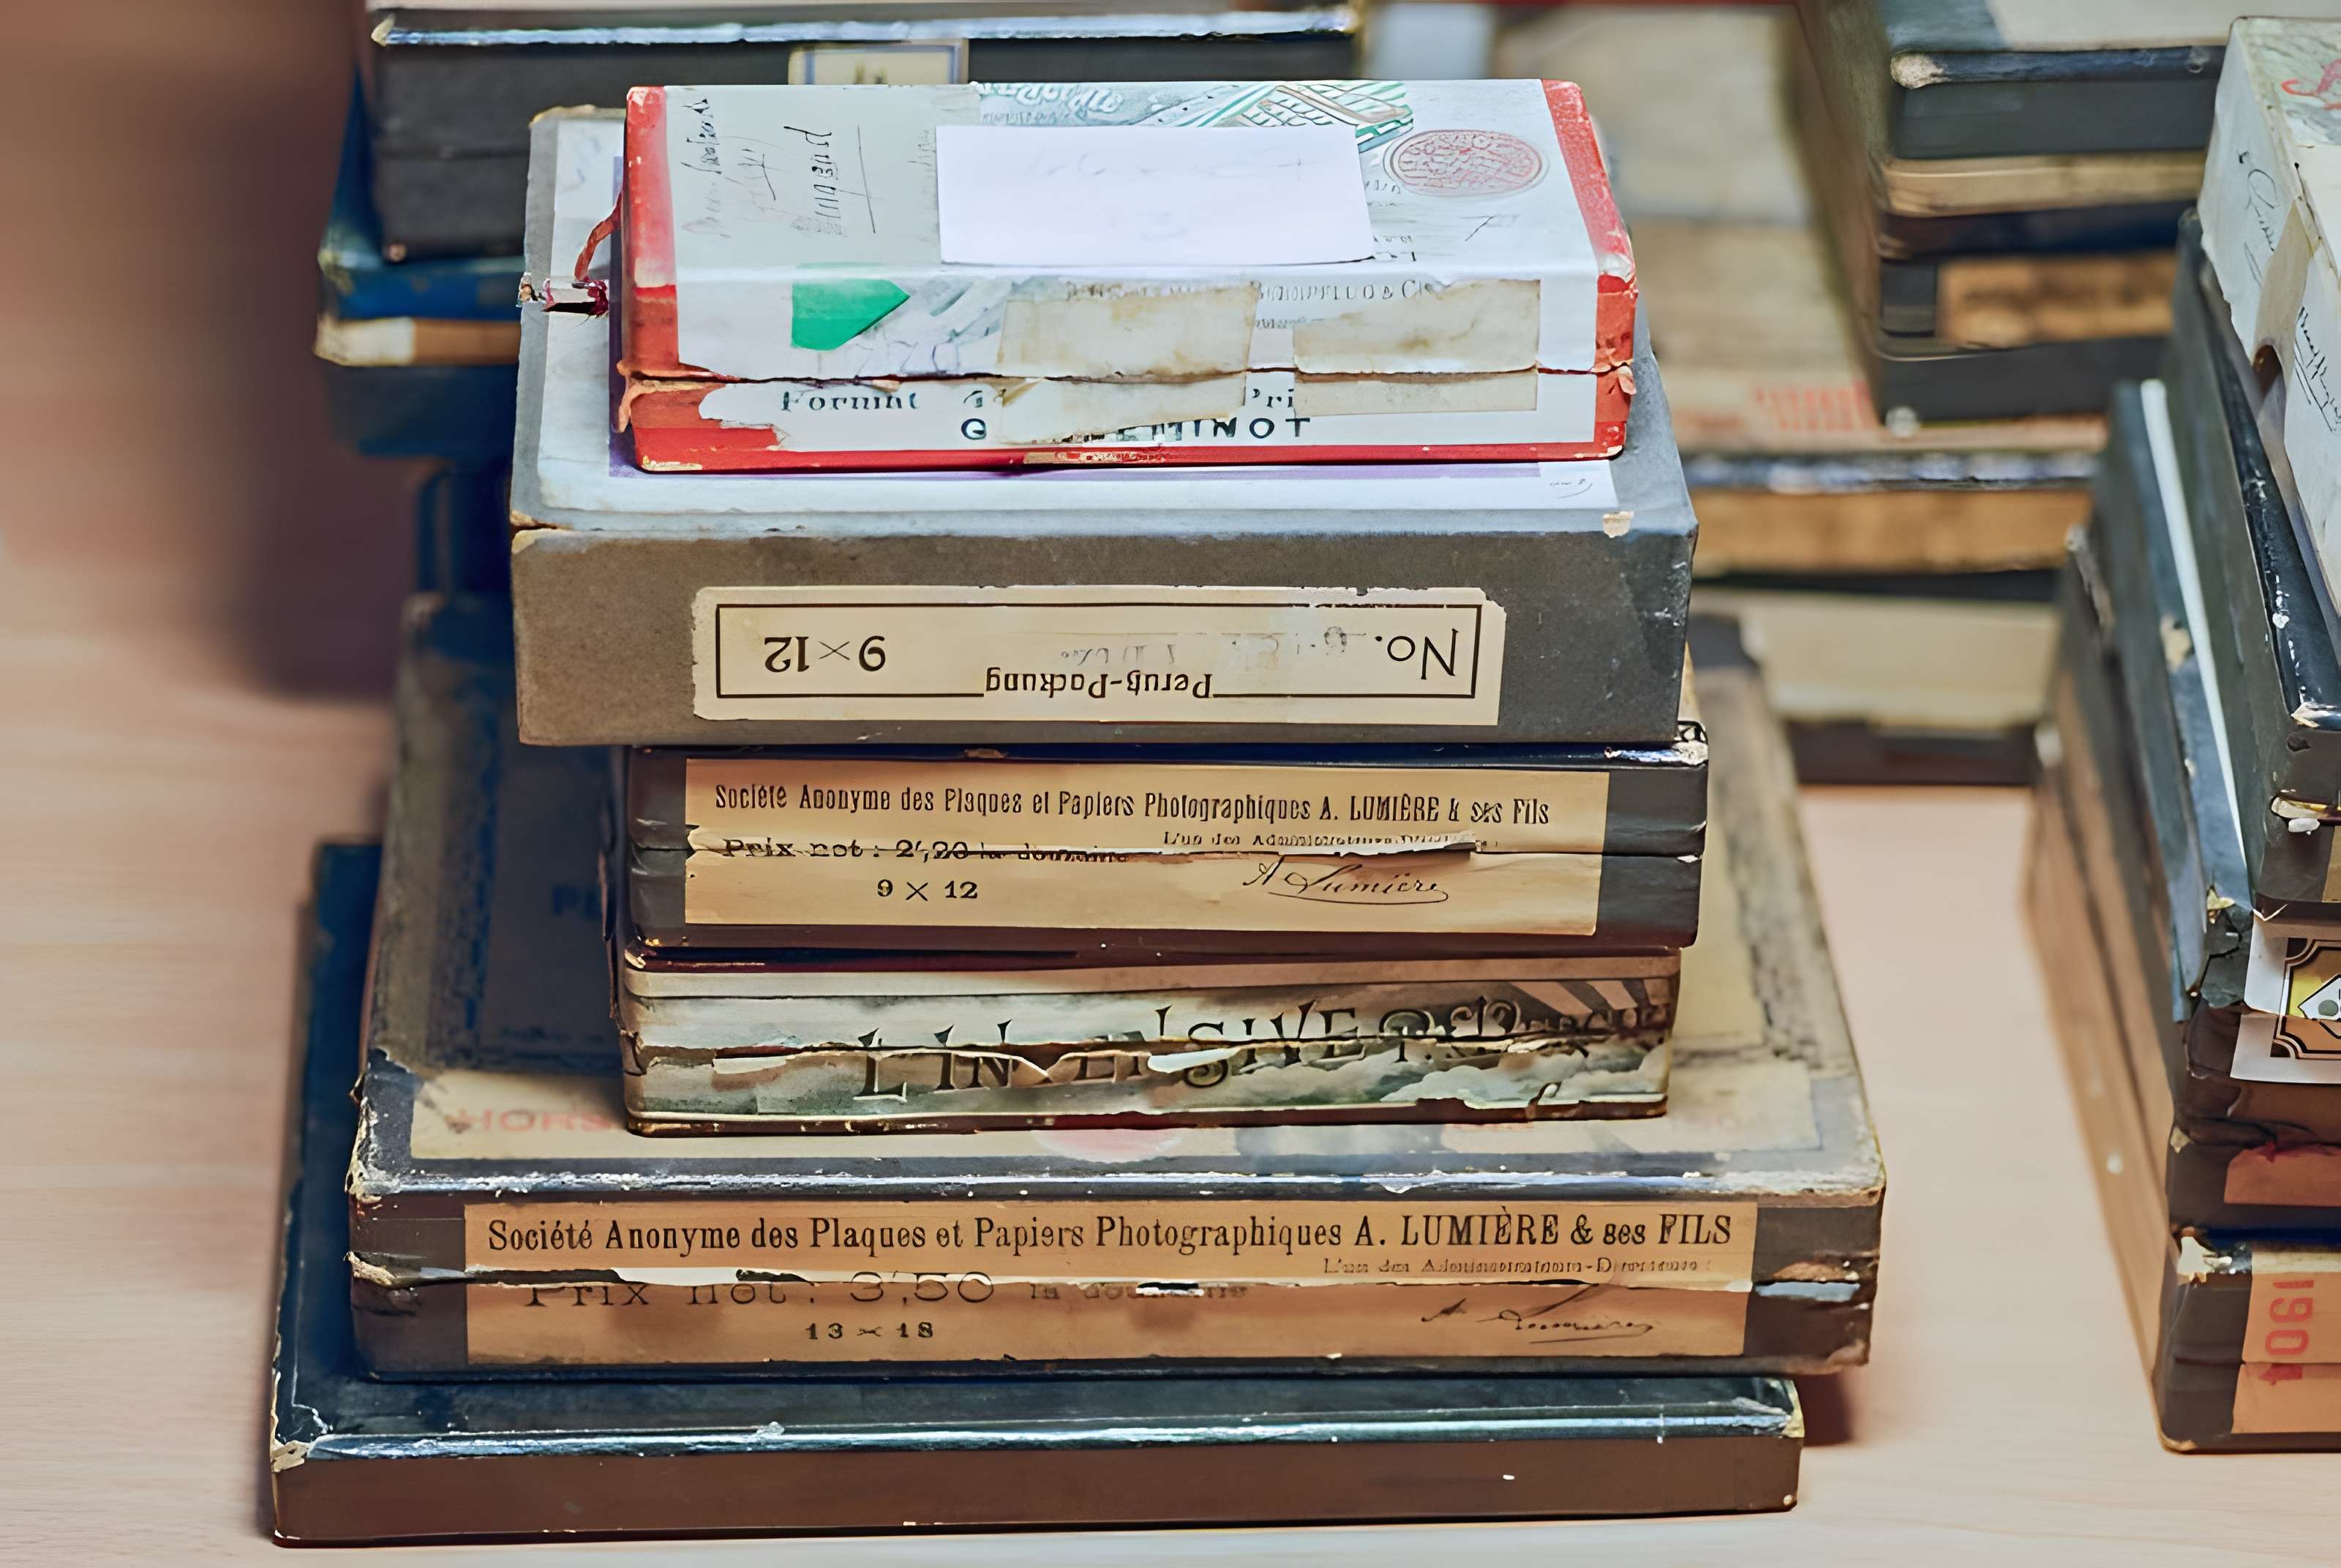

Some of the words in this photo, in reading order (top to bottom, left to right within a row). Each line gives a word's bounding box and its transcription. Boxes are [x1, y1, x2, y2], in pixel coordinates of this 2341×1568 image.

[1375, 627, 1459, 680] No.
[799, 784, 890, 813] Anonyme
[901, 787, 934, 811] des
[945, 788, 1022, 816] Plaques
[1033, 791, 1049, 814] et
[1059, 791, 1135, 819] Papiers
[1145, 793, 1309, 822] Photographiques
[1319, 796, 1339, 821] A.
[721, 837, 797, 857] Prix
[488, 1219, 593, 1251] Société
[605, 1219, 741, 1257] Anonyme
[751, 1218, 798, 1248] des
[809, 1217, 926, 1258] Plaques
[936, 1219, 963, 1248] et
[974, 1216, 1083, 1256] Papiers
[1096, 1215, 1342, 1256] Photographiques
[1354, 1215, 1387, 1246] A.
[1401, 1205, 1559, 1245] LUMIÈRE
[1571, 1213, 1593, 1245] &
[1603, 1222, 1647, 1245] ses
[1658, 1213, 1732, 1245] FILS
[805, 1322, 843, 1340] 13
[899, 1322, 934, 1339] 18
